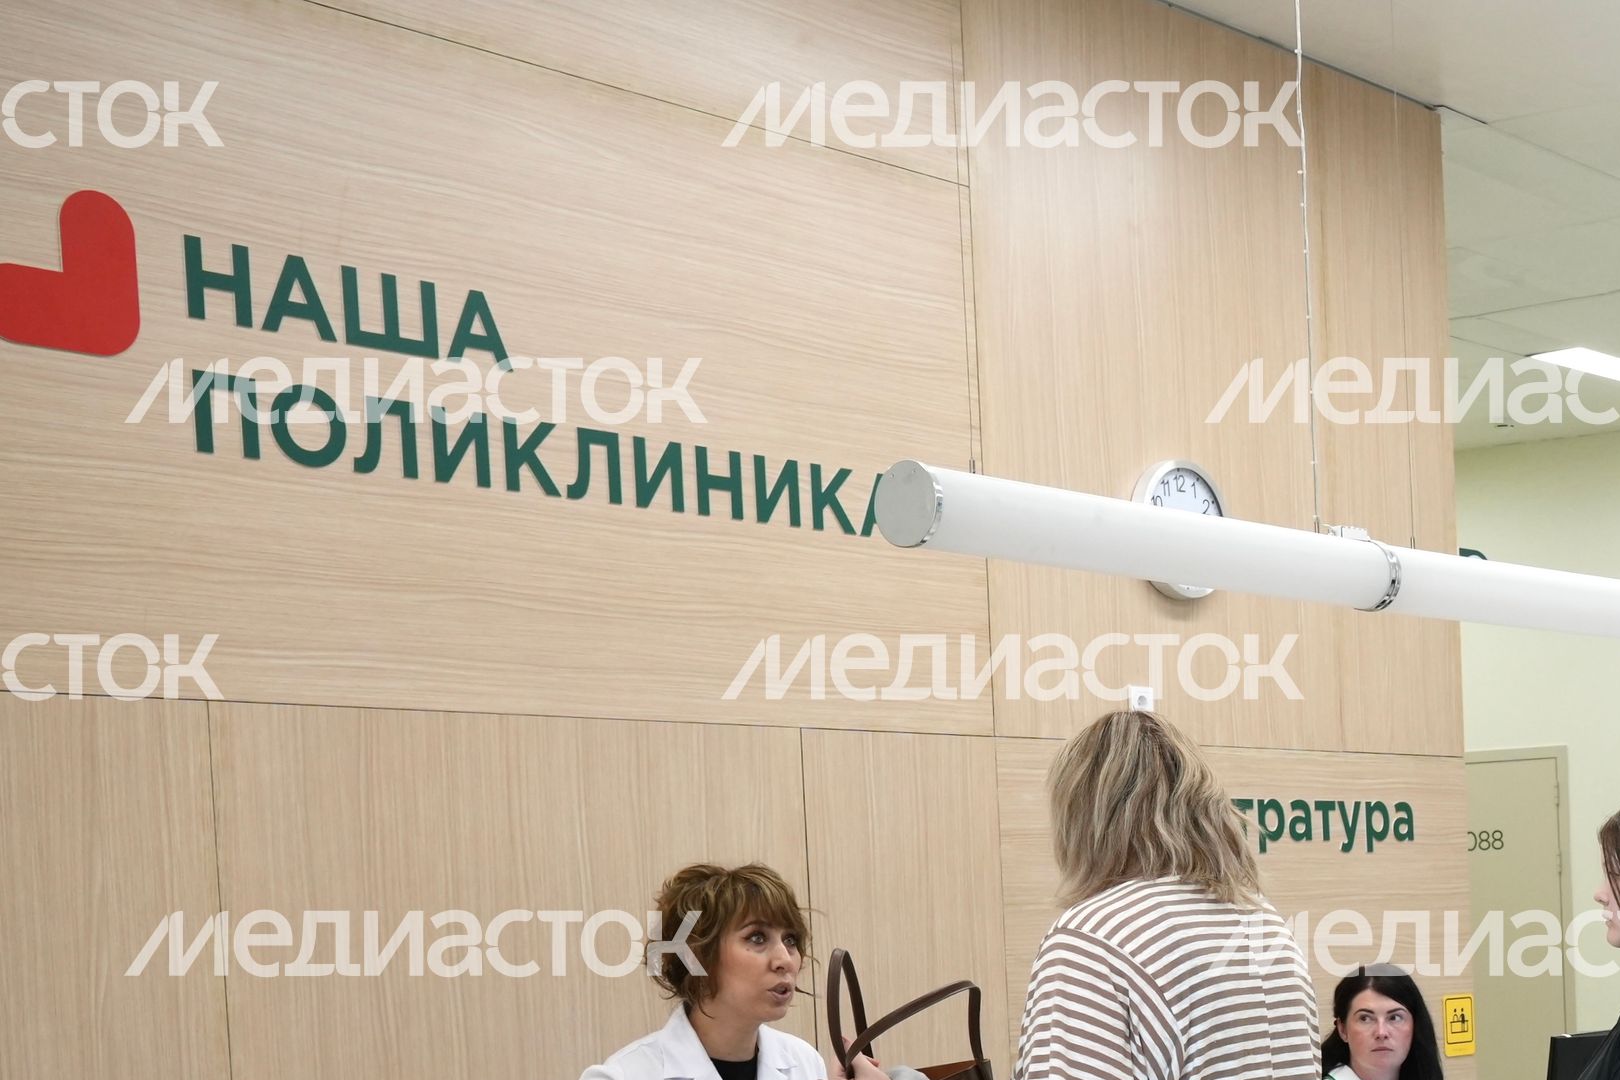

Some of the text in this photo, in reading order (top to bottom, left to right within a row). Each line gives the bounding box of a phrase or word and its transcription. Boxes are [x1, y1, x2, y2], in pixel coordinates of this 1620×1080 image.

[183, 233, 514, 372] НАША
[1161, 479, 1171, 497] 11
[1173, 474, 1186, 493] 12
[1191, 481, 1197, 499] 1
